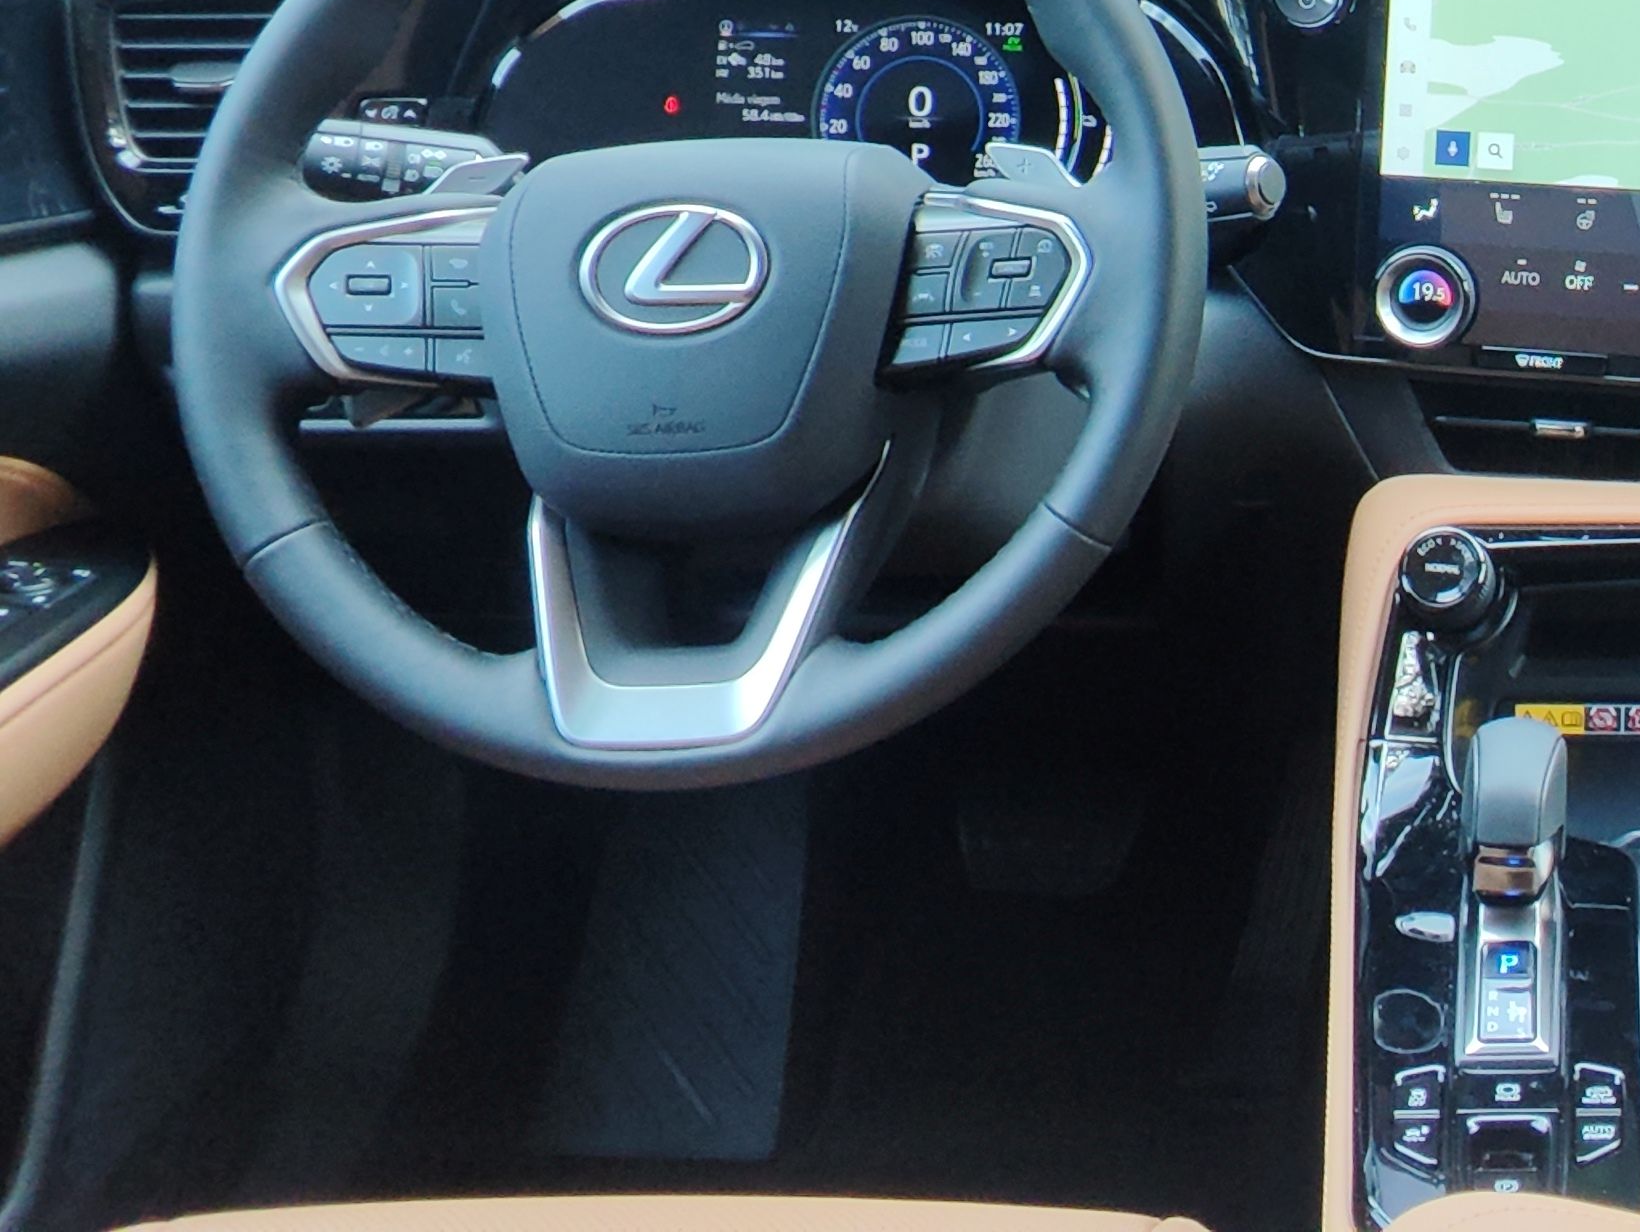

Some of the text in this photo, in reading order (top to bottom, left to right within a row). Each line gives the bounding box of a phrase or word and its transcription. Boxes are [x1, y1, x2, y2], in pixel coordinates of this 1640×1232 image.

[985, 22, 1025, 36] 11:07
[879, 37, 899, 52] 80
[911, 31, 934, 45] 100
[951, 42, 972, 57] 140
[852, 55, 871, 70] 60
[833, 83, 853, 98] 40
[908, 86, 933, 116] 0
[828, 118, 848, 134] 20
[988, 112, 1010, 128] 220
[911, 143, 930, 165] P
[1501, 271, 1540, 287] AUTO
[1565, 274, 1594, 291] OFF
[1412, 281, 1445, 303] 19.5
[1500, 953, 1519, 974] P
[1486, 1005, 1500, 1017] N
[1486, 1021, 1499, 1033] D
